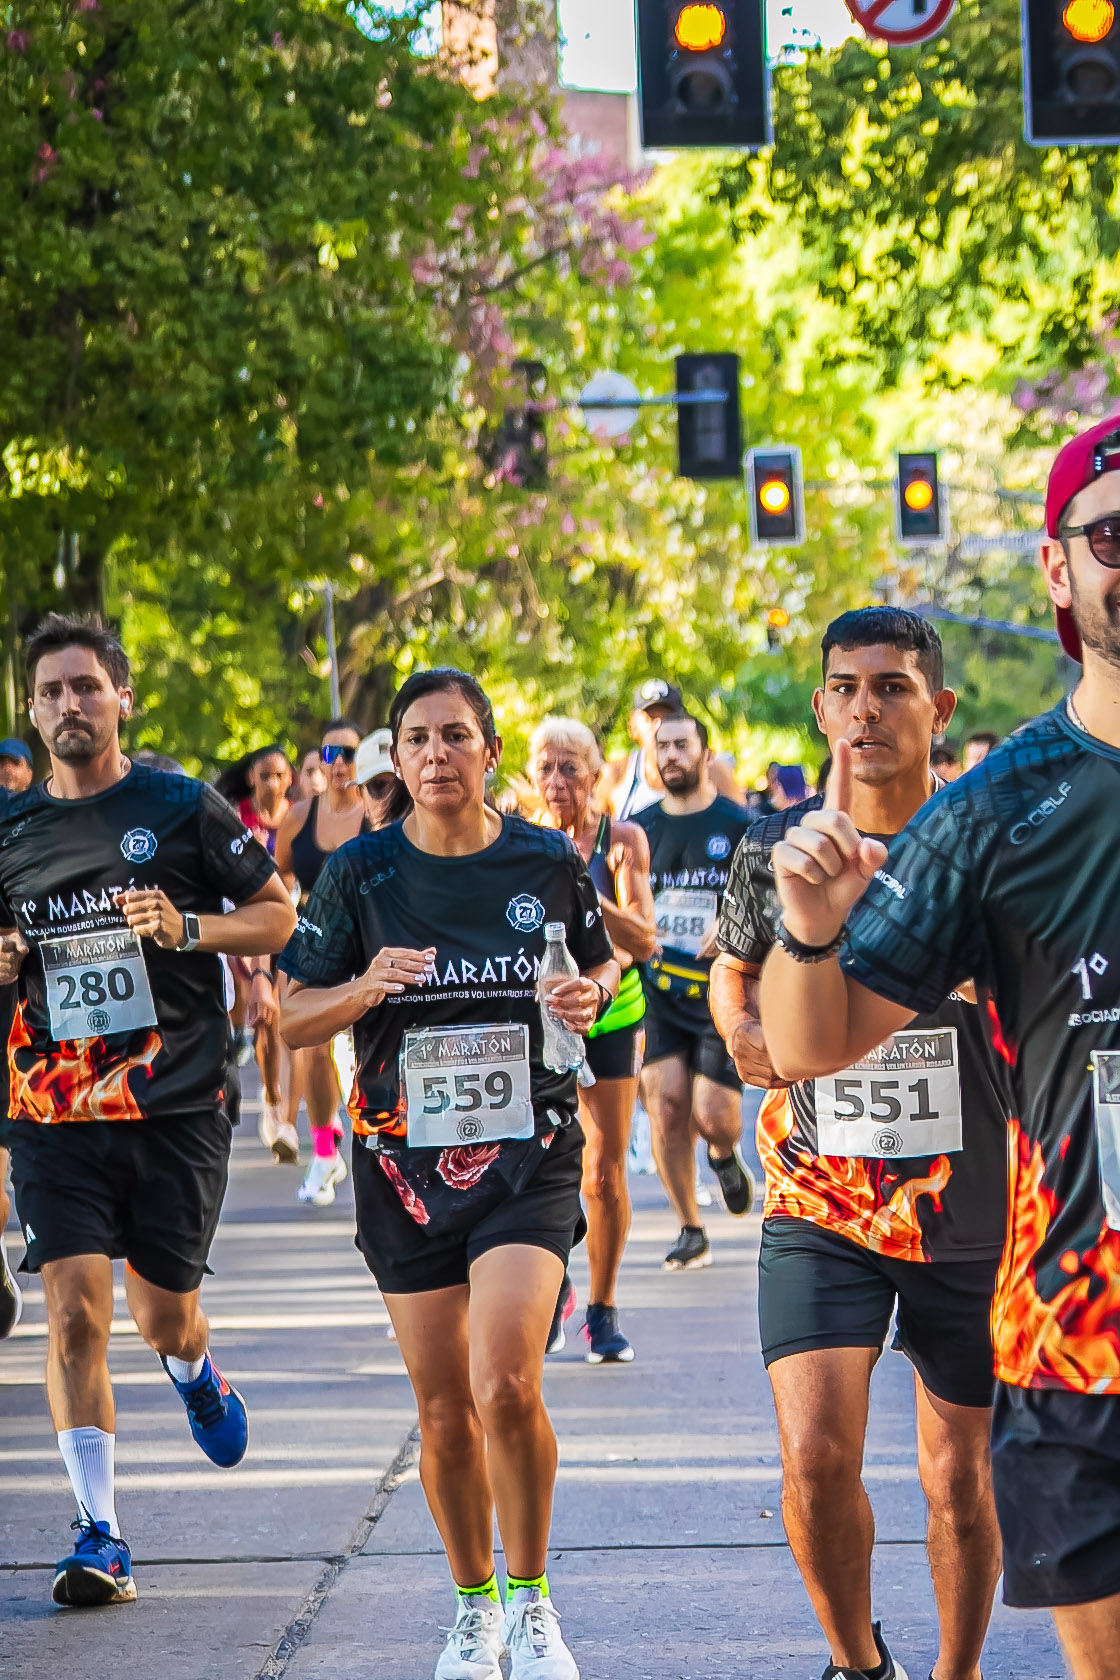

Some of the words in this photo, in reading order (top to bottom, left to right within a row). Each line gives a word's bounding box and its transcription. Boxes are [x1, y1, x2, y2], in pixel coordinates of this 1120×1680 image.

[874, 869, 907, 900] NICIPAL
[49, 878, 160, 921] MARAT
[657, 914, 705, 937] 488
[66, 935, 126, 959] MARATÓN
[57, 967, 135, 1010] 280
[471, 989, 524, 999] VOLUNTARIOS
[438, 1035, 511, 1057] MARATÓN
[862, 1038, 936, 1061] ARATÓN
[422, 1070, 513, 1115] 559
[834, 1078, 940, 1124] 551
